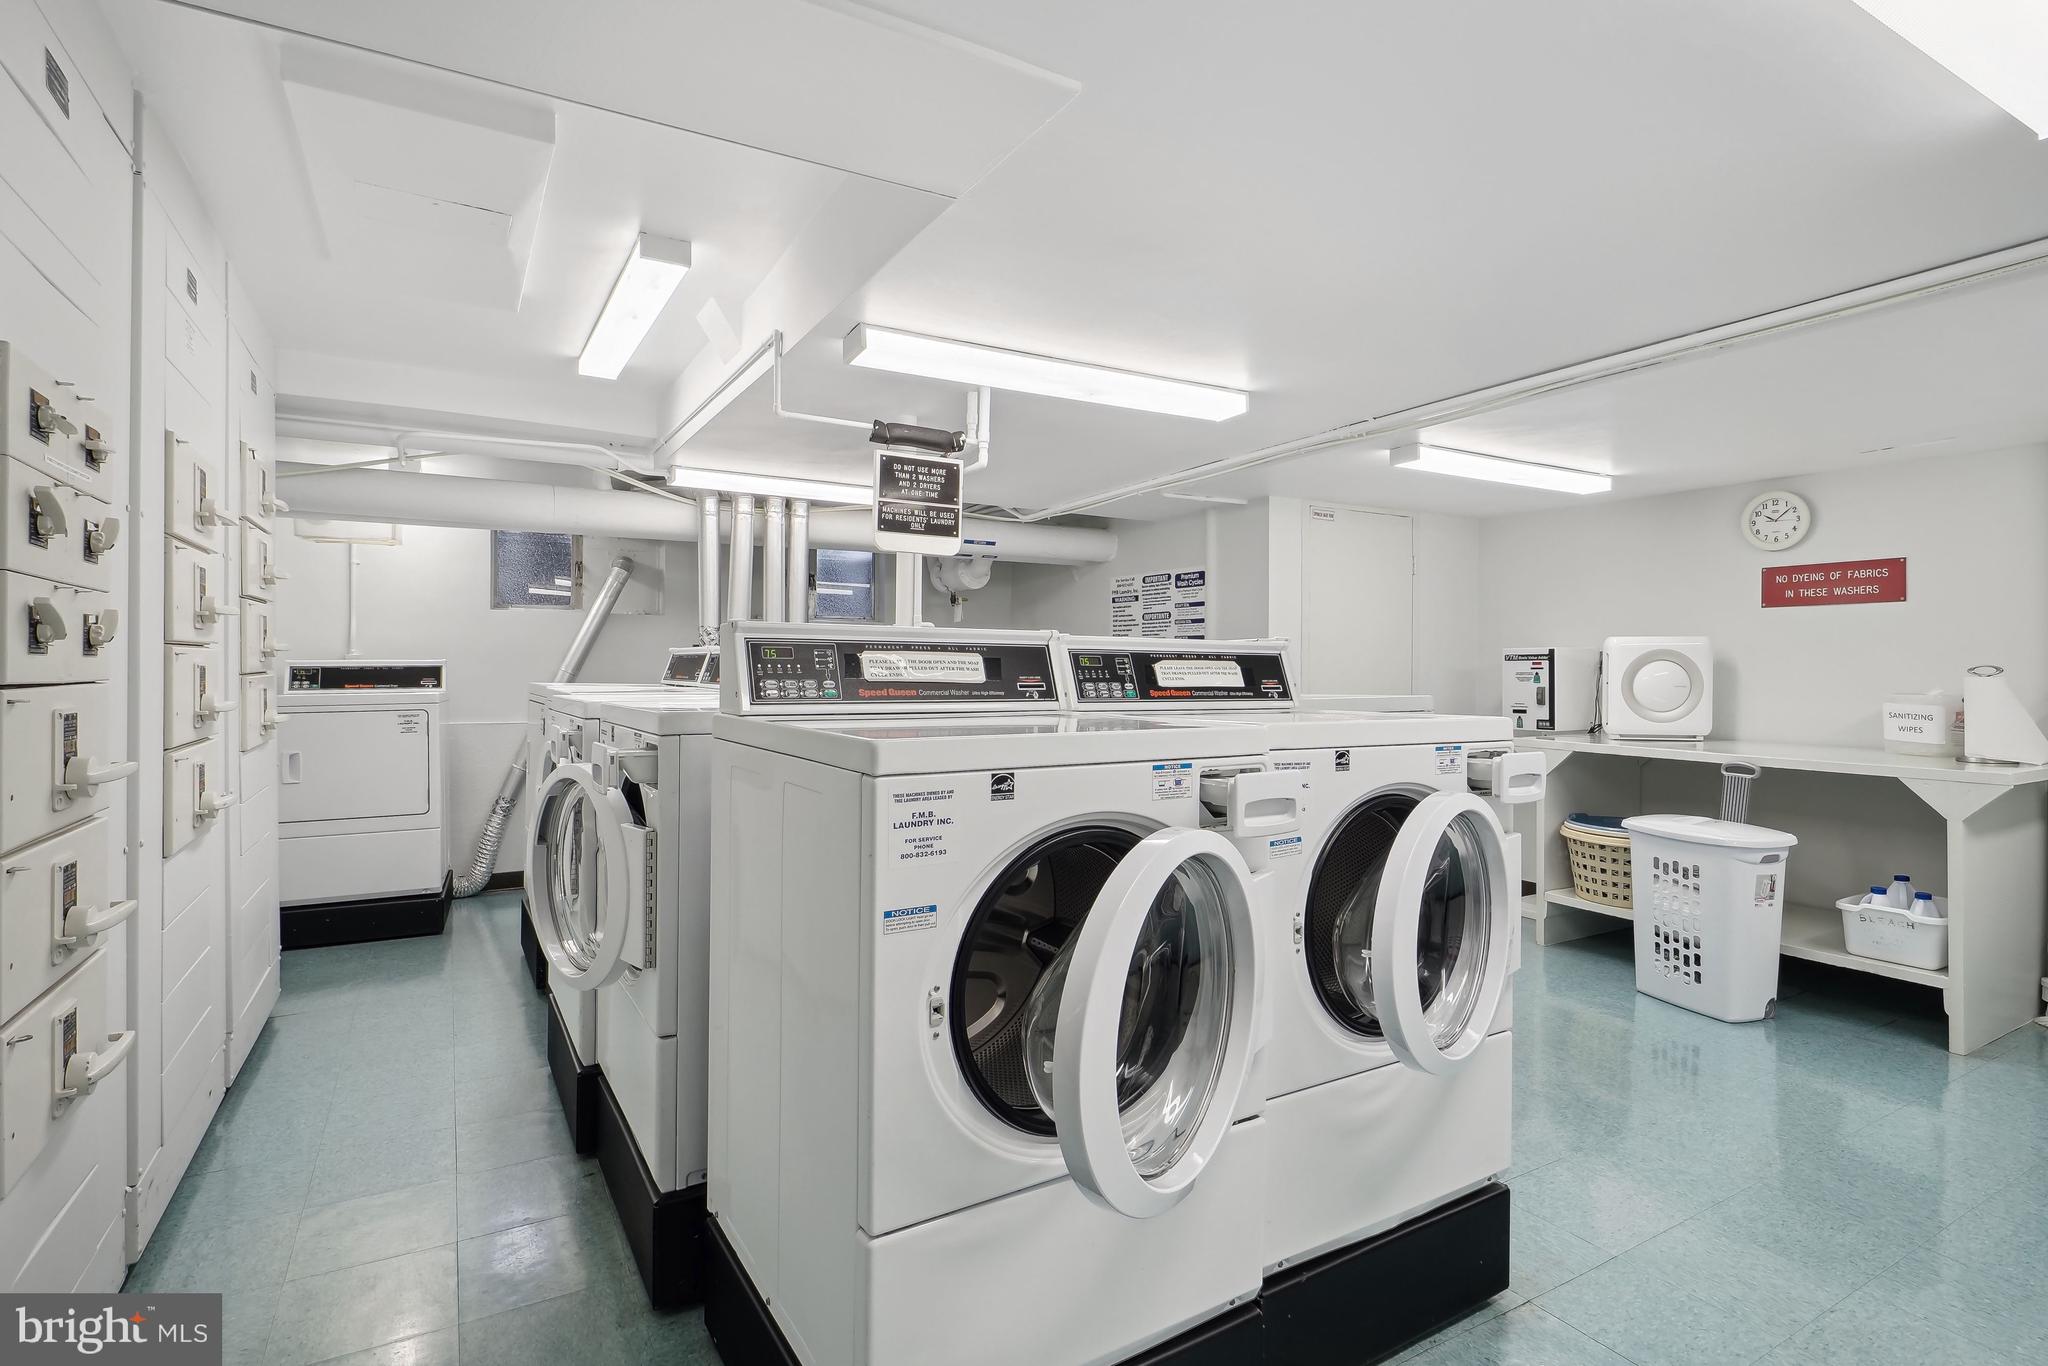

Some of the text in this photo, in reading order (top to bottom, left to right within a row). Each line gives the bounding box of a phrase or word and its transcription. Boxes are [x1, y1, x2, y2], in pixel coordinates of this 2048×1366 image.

[918, 475, 945, 483] WASHERS
[882, 506, 911, 515] MACHINES
[914, 509, 927, 517] WILL
[940, 511, 955, 519] USED
[896, 514, 928, 523] RESIDENTS'
[930, 518, 956, 526] LAUNDRY
[1145, 574, 1169, 583] IMPORTANT
[1776, 568, 1889, 584] NO DYEING OF FABRICS
[1785, 585, 1880, 598] IN THESE WASHERS
[1144, 612, 1170, 620] IMPORTANTE
[858, 688, 888, 697] Speed
[889, 688, 916, 697] Queen
[918, 689, 949, 697] Commercial
[950, 689, 970, 697] Washer
[1150, 689, 1170, 697] Speed
[1888, 711, 1934, 721] SANITIZING
[1898, 725, 1923, 733] WIPES
[912, 811, 936, 819] F.M.B.
[893, 820, 934, 829] LAUNDRY
[1274, 837, 1298, 846] NOTICE
[900, 849, 947, 859] 800-832-6193
[892, 907, 930, 917] NOTICE
